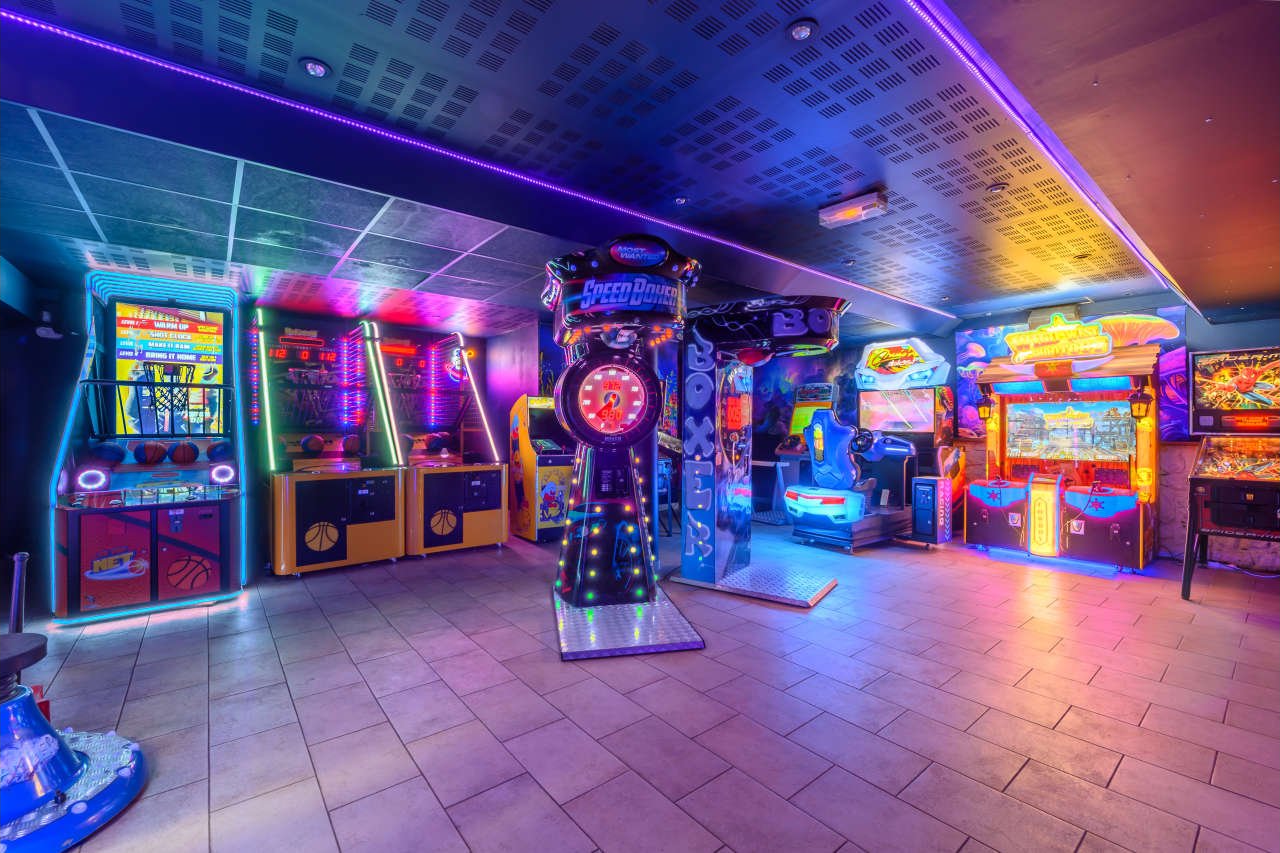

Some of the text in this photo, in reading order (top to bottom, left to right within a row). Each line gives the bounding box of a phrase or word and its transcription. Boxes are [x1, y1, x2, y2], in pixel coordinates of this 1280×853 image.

[580, 279, 632, 309] SPEED
[154, 321, 177, 330] WARM
[179, 323, 189, 331] UP
[150, 331, 168, 339] SHOT
